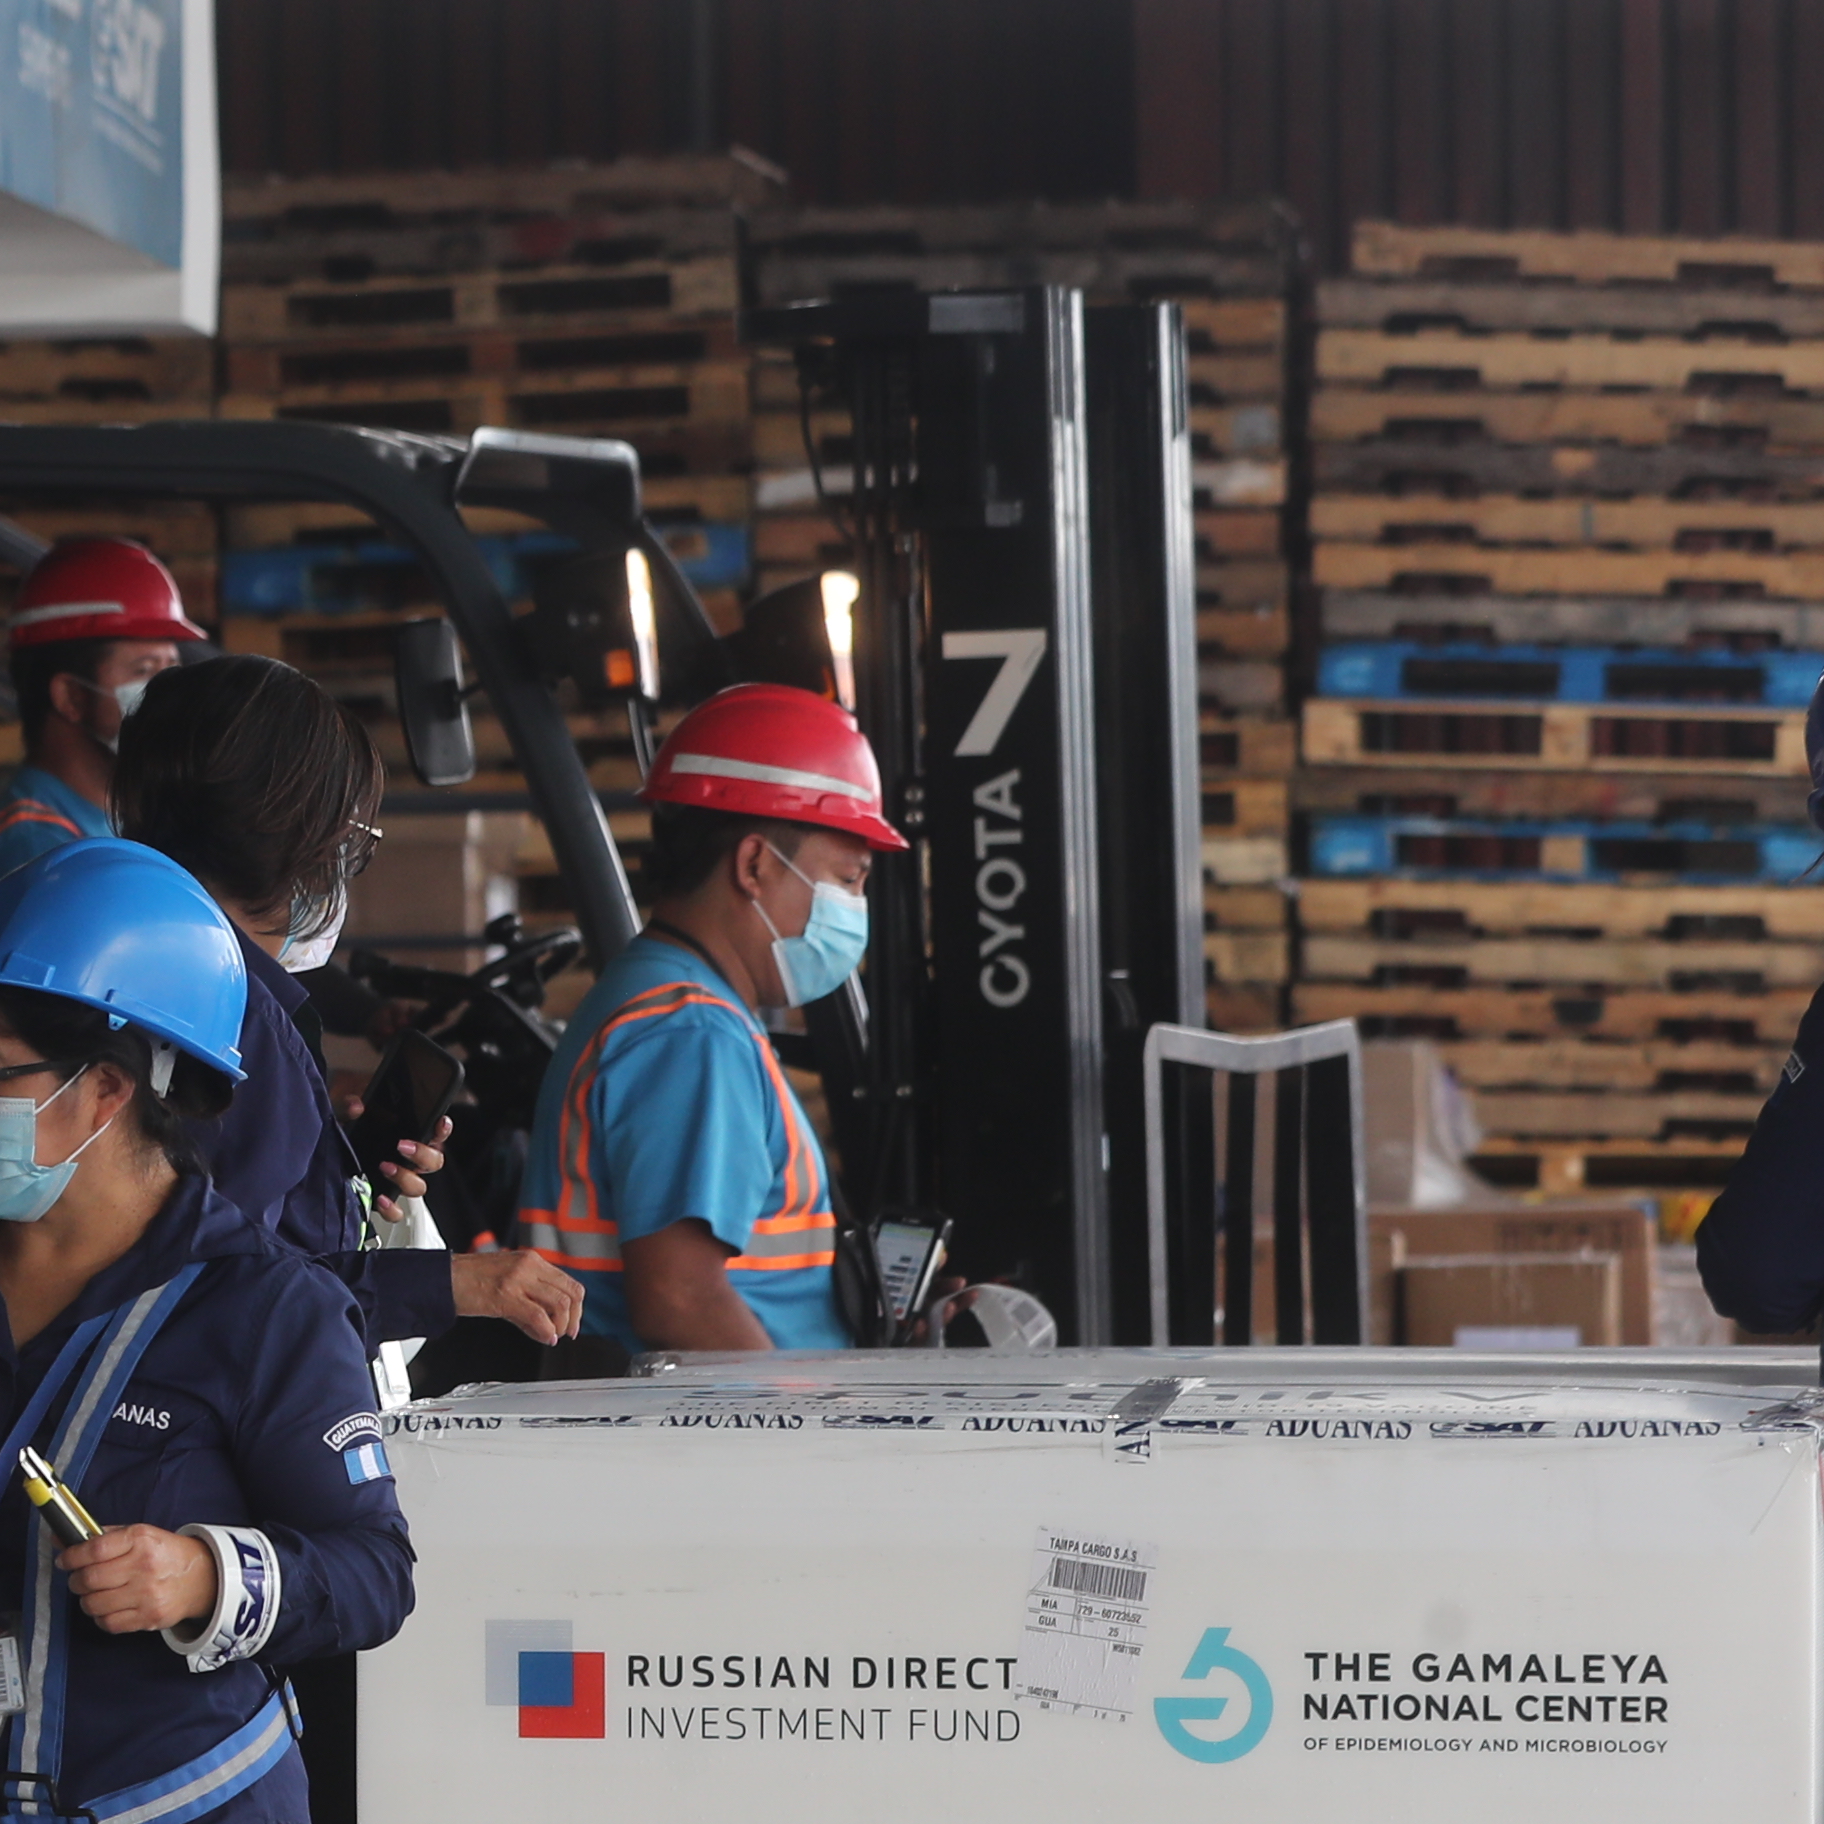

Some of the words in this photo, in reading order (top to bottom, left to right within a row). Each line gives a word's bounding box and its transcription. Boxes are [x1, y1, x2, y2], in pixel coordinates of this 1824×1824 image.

[941, 627, 1048, 757] 7
[113, 1401, 172, 1431] ANAS
[1081, 1543, 1112, 1560] CARGO
[1107, 1626, 1120, 1638] 25
[628, 1656, 828, 1688] RUSSIAN
[853, 1657, 1017, 1690] DIRECT
[1304, 1652, 1390, 1682] THE
[1412, 1653, 1668, 1684] GAMALEYA
[1304, 1694, 1502, 1721] NATIONAL
[1516, 1695, 1667, 1722] CENTER
[628, 1707, 892, 1740] INVESTMENT
[910, 1710, 1020, 1741] FUND
[1304, 1738, 1328, 1750] OF
[1336, 1738, 1472, 1751] EPIDEMIOLOGY
[1480, 1739, 1518, 1752] AND
[1526, 1740, 1667, 1753] MICROBIOLOGY
